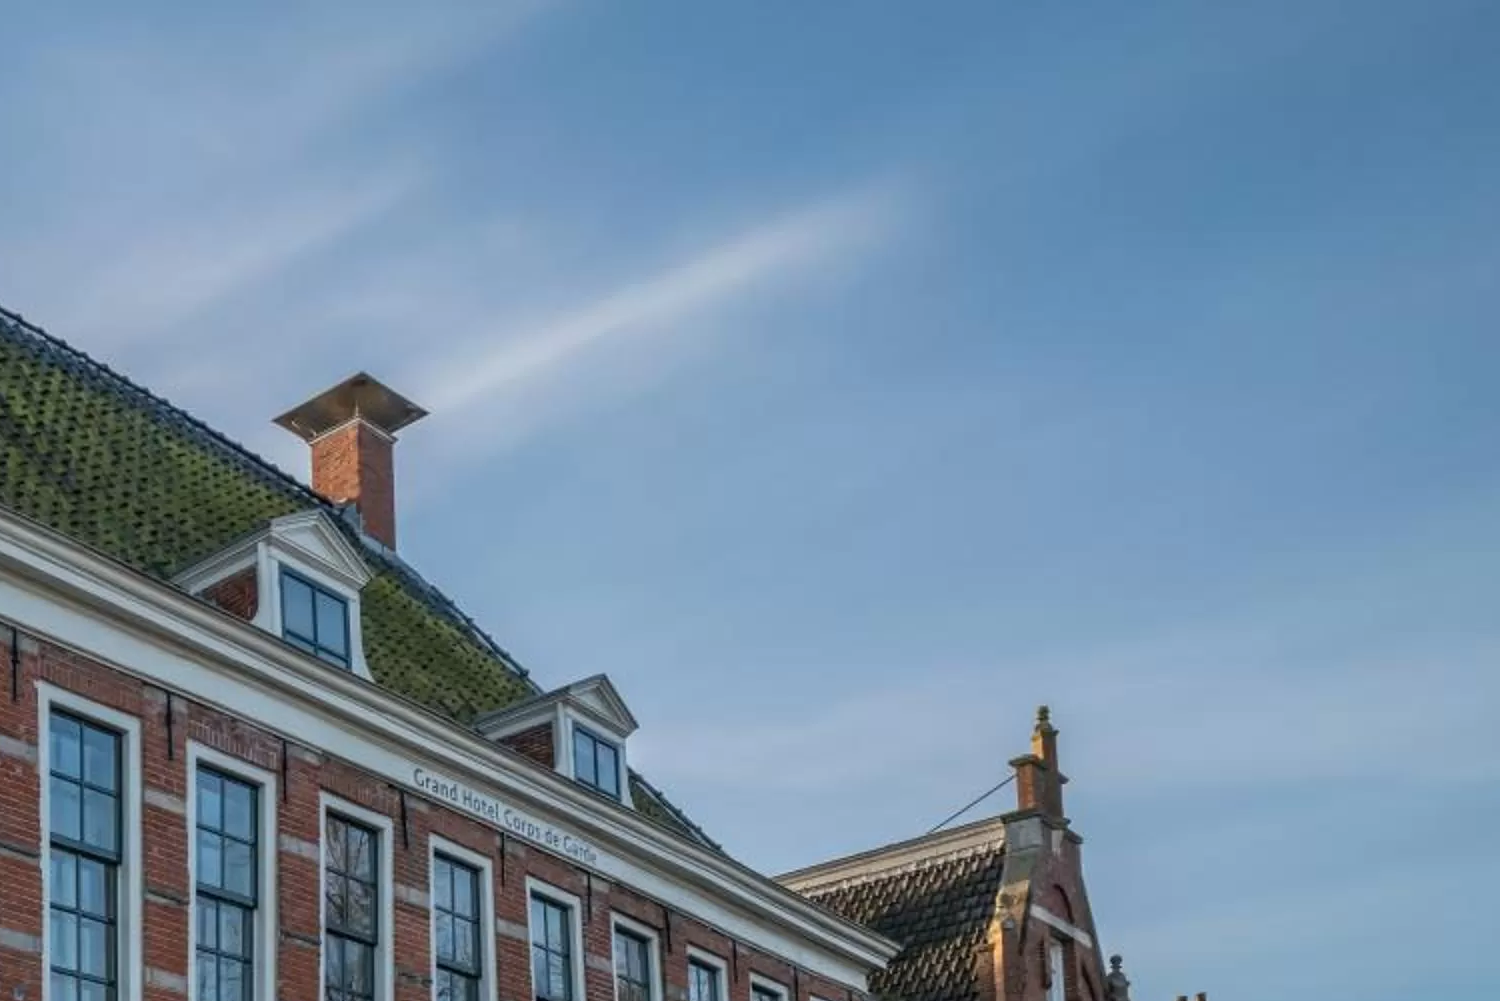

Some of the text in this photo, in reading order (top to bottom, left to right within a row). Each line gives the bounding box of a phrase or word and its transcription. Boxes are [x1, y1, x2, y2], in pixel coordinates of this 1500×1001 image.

[414, 768, 457, 801] Grand
[463, 789, 498, 820] Hotel
[504, 809, 540, 839] Corps
[545, 829, 559, 847] de
